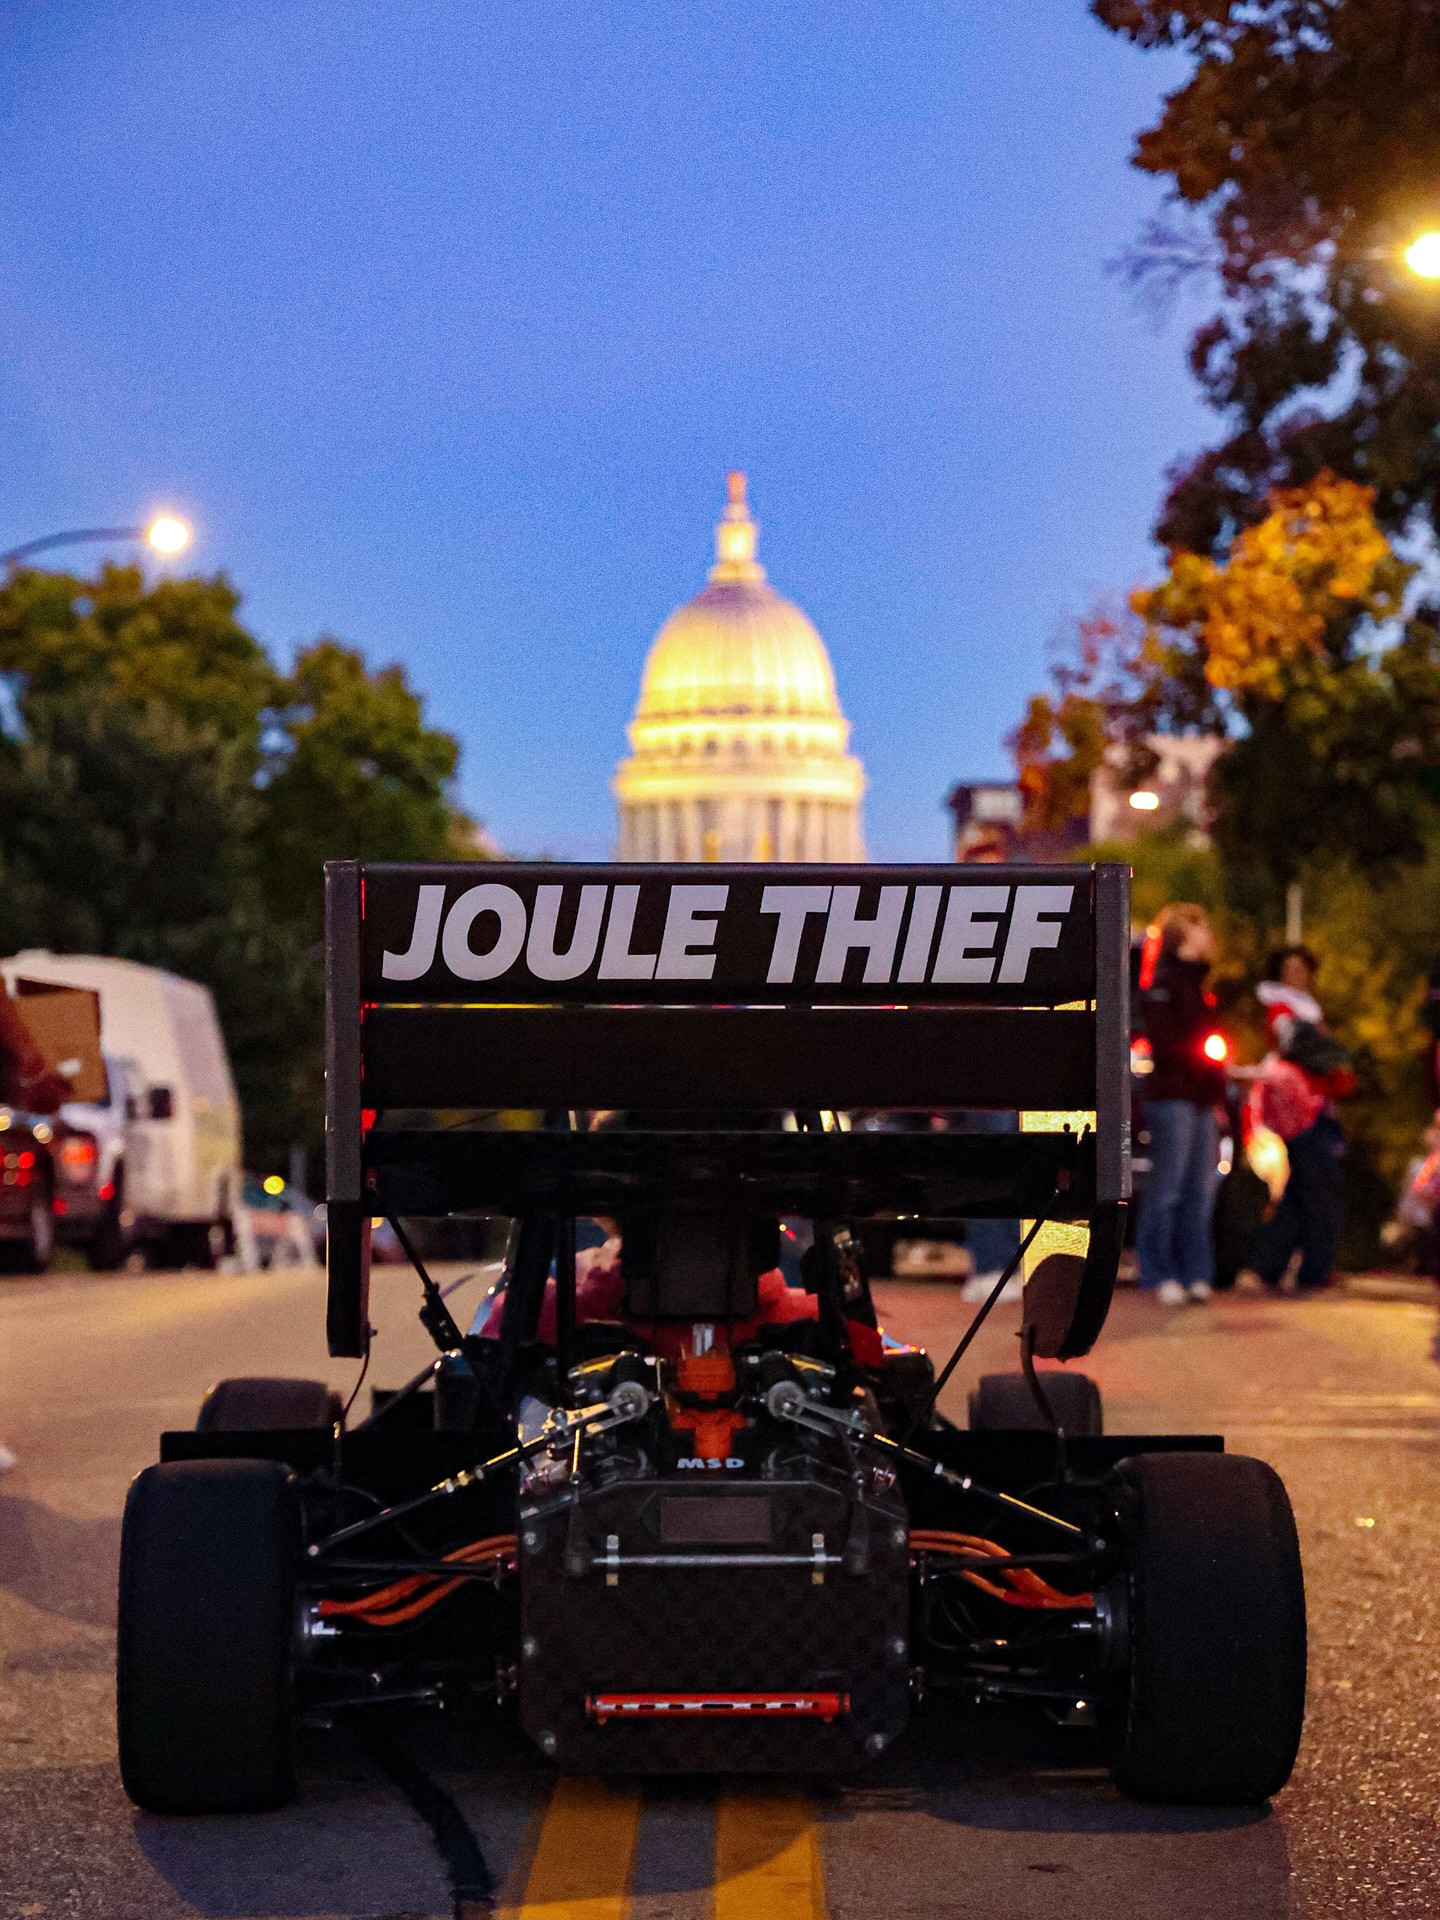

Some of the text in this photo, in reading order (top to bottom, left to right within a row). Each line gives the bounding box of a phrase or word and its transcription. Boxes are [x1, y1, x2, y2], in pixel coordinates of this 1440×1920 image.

[382, 884, 1075, 984] JOULE THIEF
[677, 1458, 745, 1469] MSD
